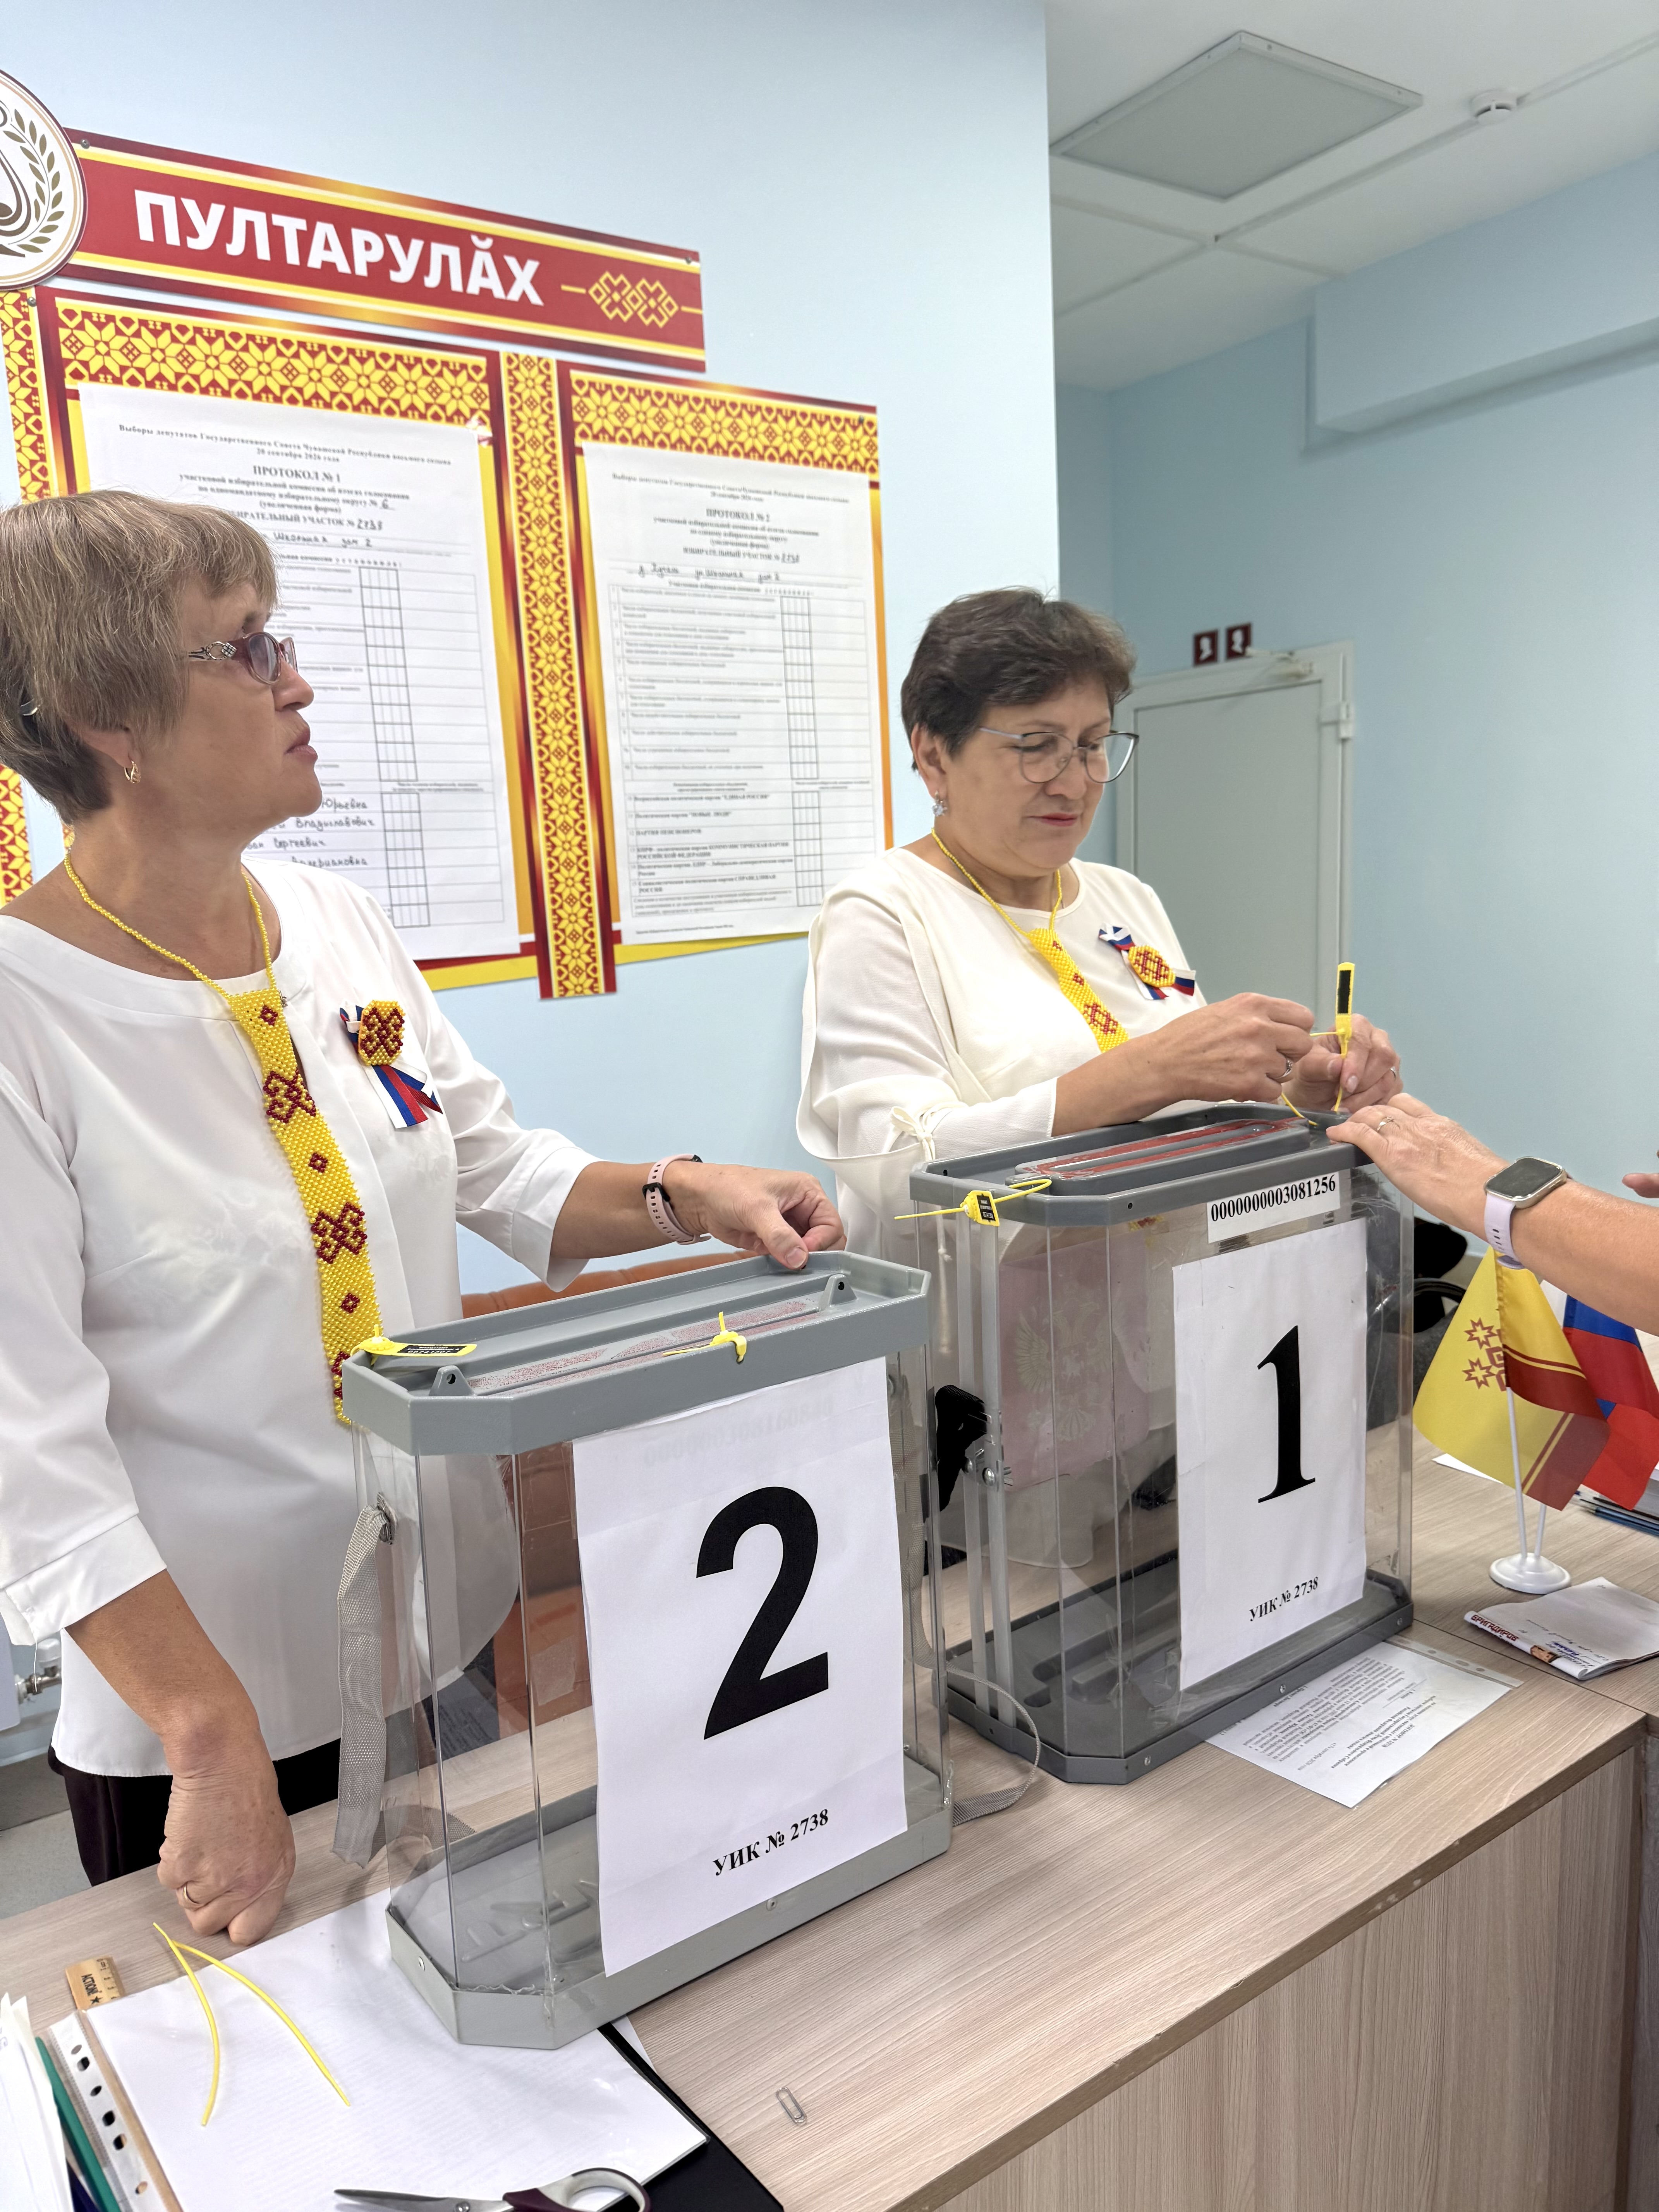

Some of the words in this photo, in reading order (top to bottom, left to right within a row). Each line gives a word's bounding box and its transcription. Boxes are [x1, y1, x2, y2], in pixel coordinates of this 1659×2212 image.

[253, 465, 319, 481] ПРОТОКОЛ
[322, 472, 333, 482] №
[337, 474, 340, 483] 1
[1211, 1175, 1336, 1221] 0000000003081256
[1257, 1325, 1316, 1503] 1
[696, 1486, 828, 1740] 2
[1249, 1597, 1278, 1622] УИК
[1279, 1590, 1291, 1608] №
[1293, 1576, 1319, 1602] 2738
[713, 1841, 760, 1876] УИК
[766, 1830, 785, 1851] №
[790, 1808, 829, 1841] 2738
